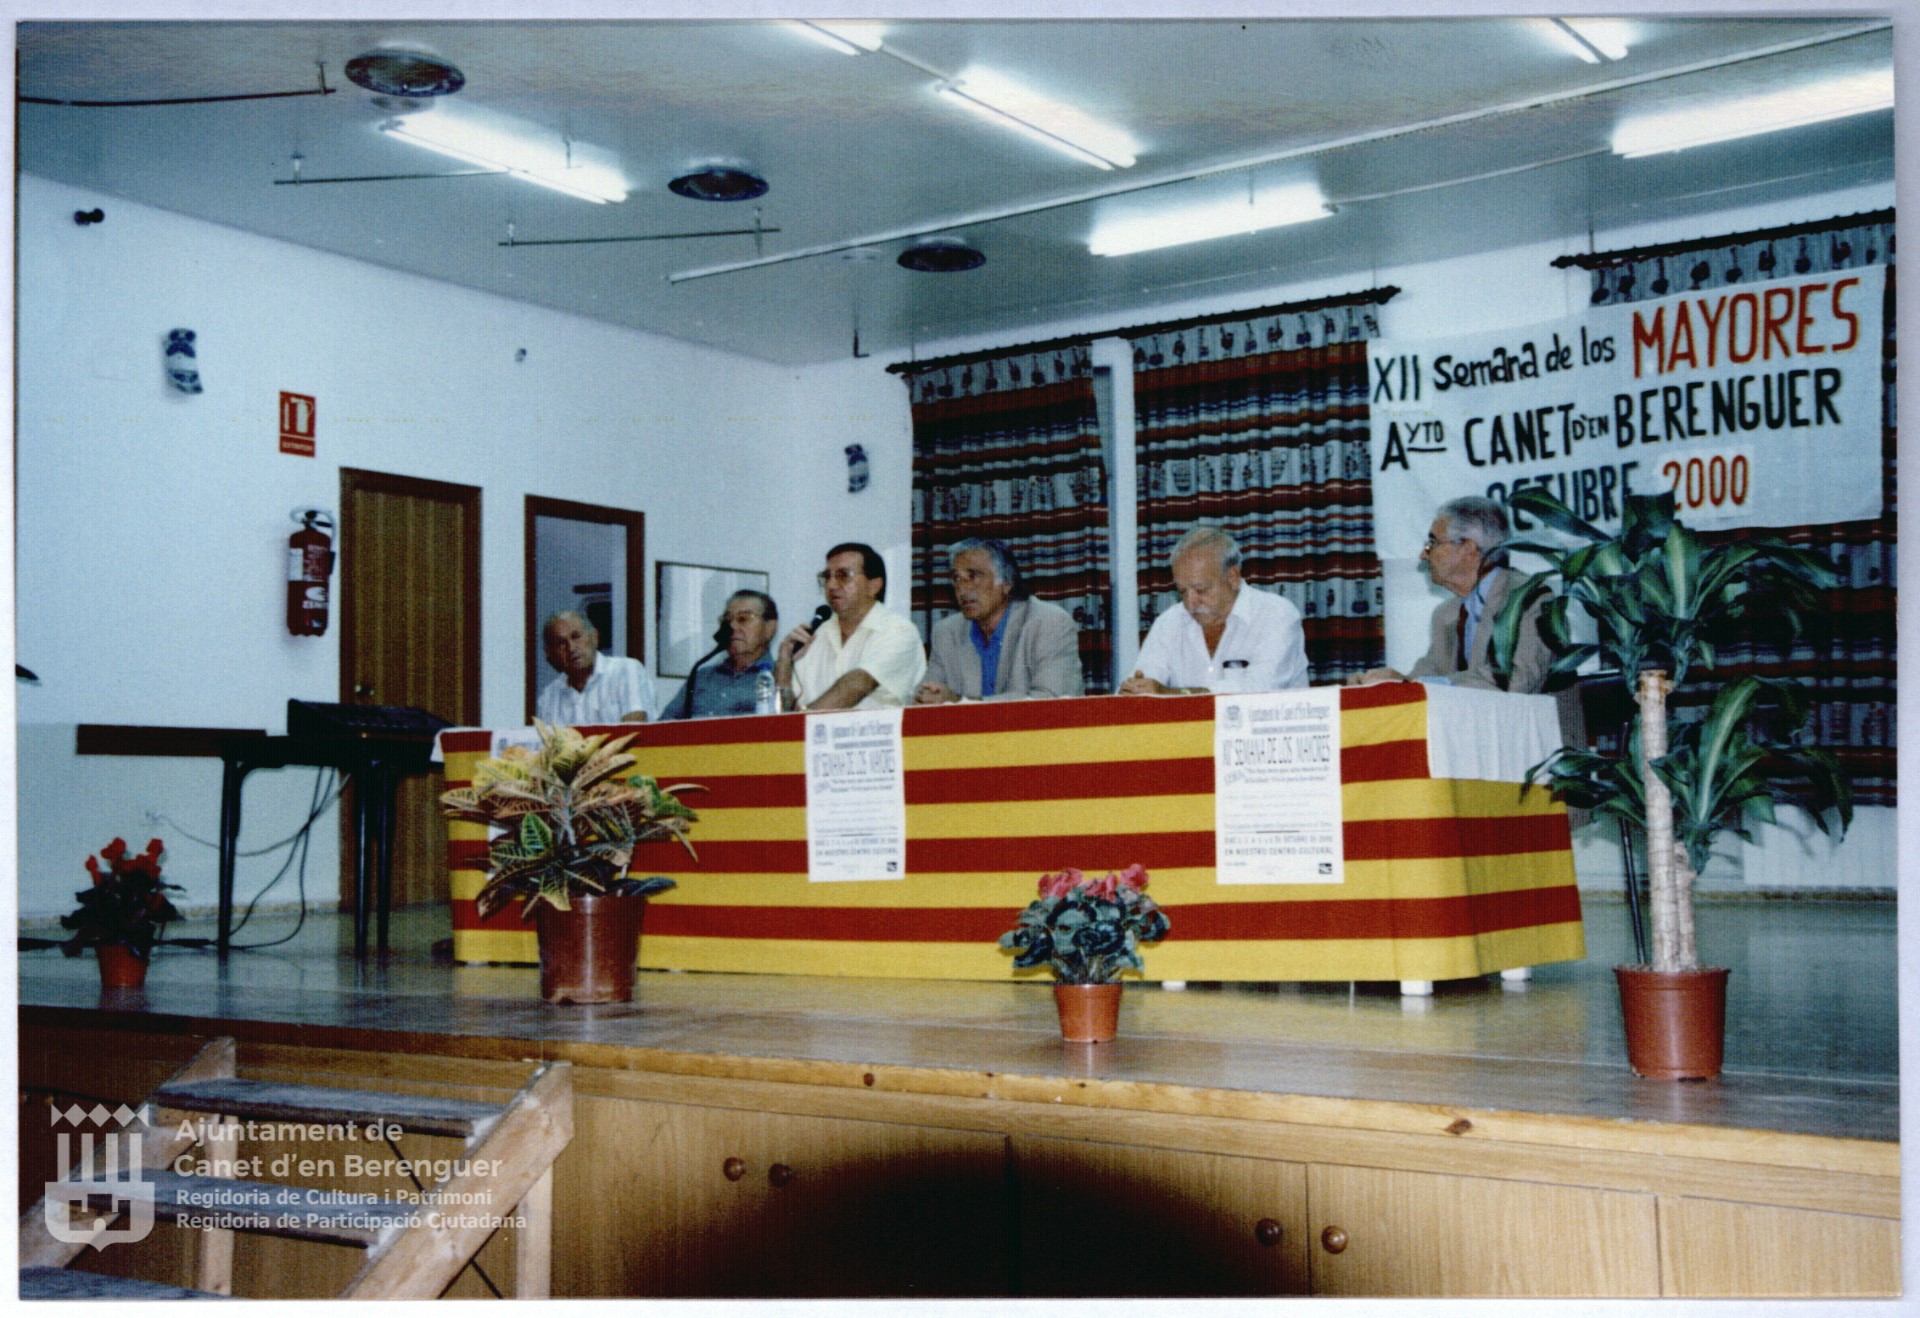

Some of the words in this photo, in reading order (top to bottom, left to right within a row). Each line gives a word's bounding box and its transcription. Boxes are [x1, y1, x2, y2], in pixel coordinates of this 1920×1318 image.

[1374, 355, 1420, 403] XII
[1433, 341, 1540, 391] Semana
[1545, 333, 1573, 373] de
[1581, 325, 1616, 366] los
[1632, 277, 1860, 379] MAYORES
[1464, 402, 1575, 467] CANET
[1614, 368, 1842, 448] BERENGUER
[1662, 455, 1749, 511] 2000
